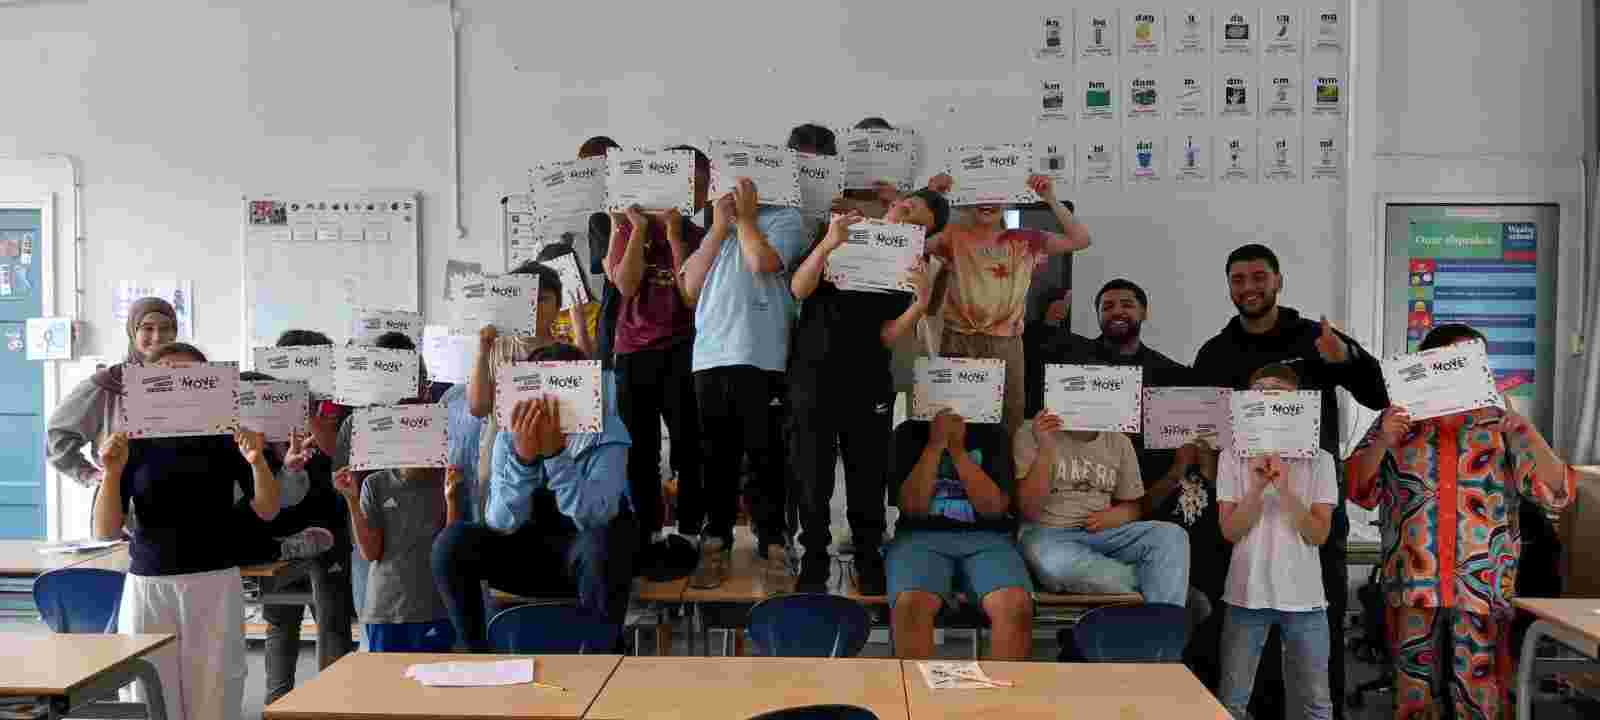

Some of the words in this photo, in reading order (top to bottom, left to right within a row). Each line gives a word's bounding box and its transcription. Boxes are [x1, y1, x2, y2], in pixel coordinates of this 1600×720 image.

[1088, 80, 1104, 89] hm
[1227, 76, 1243, 86] dm
[1273, 77, 1289, 85] cm
[1432, 355, 1466, 372] MOVE
[182, 376, 217, 390] MOVE
[549, 375, 580, 388] MOVE
